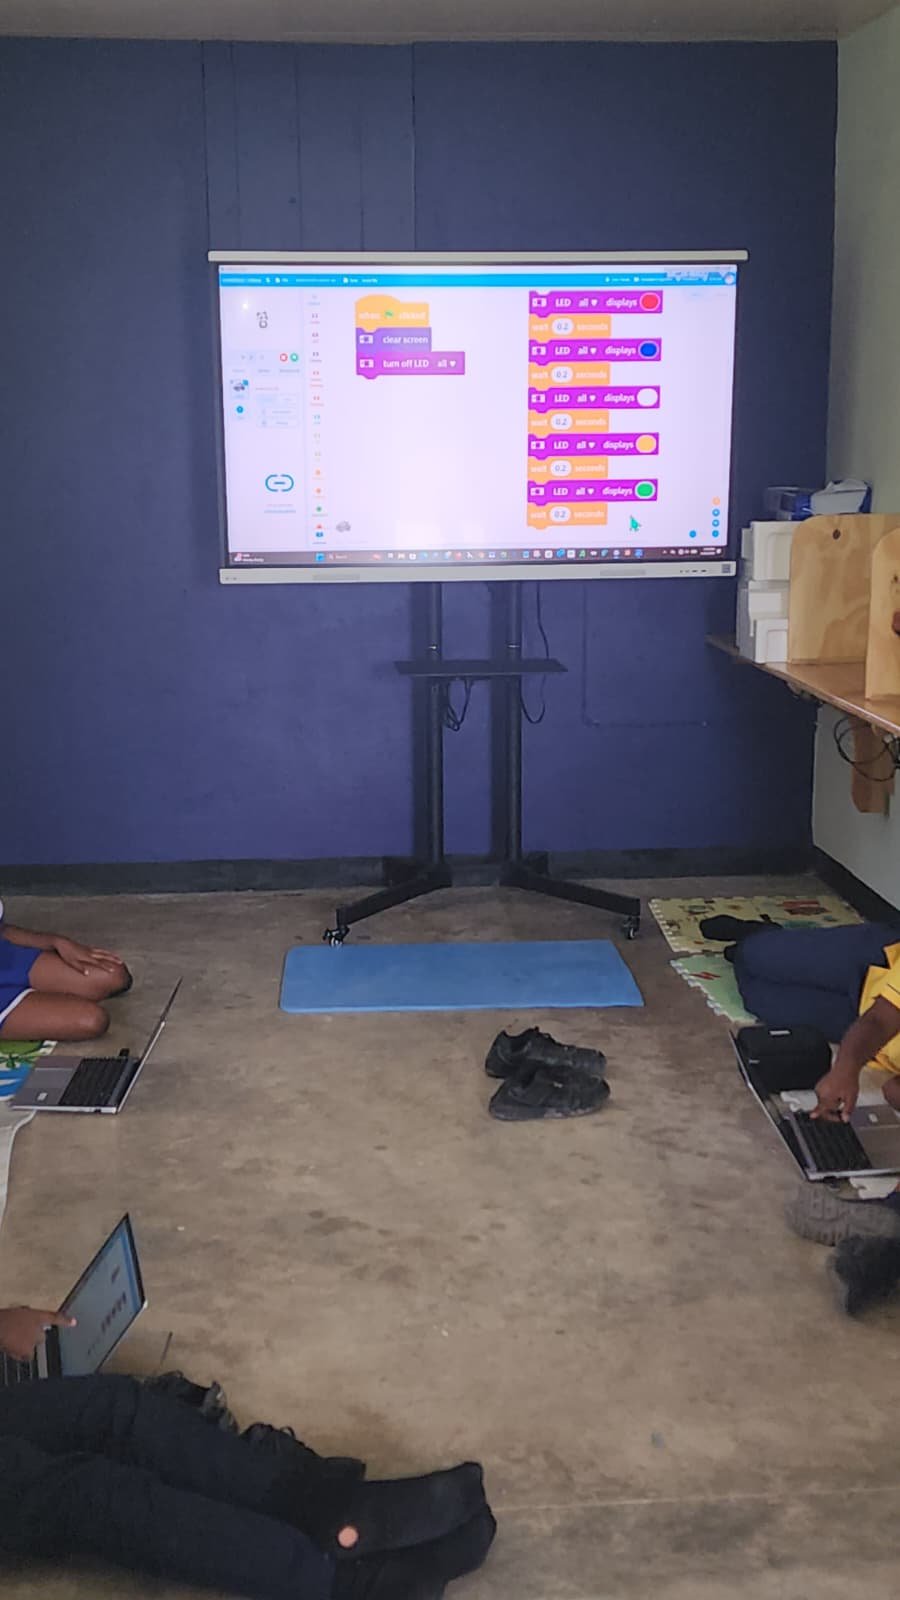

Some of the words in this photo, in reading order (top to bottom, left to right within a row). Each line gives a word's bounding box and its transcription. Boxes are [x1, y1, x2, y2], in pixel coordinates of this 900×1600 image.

[555, 298, 572, 307] LED
[578, 298, 589, 307] all
[606, 297, 638, 309] displays
[382, 336, 401, 344] clear
[403, 336, 429, 344] screen
[554, 346, 571, 355] LED
[577, 346, 588, 355] all
[605, 345, 636, 357] displays
[383, 360, 400, 368] turn
[401, 359, 413, 368] off
[415, 359, 429, 368] LED
[437, 359, 447, 368] all
[554, 394, 570, 403] LED
[577, 394, 587, 403] all
[603, 393, 635, 404] displays
[553, 441, 569, 449] LED
[576, 441, 586, 449] all
[602, 440, 634, 451] displays
[553, 487, 569, 496] LED
[575, 487, 586, 496] all
[602, 486, 633, 497] displays
